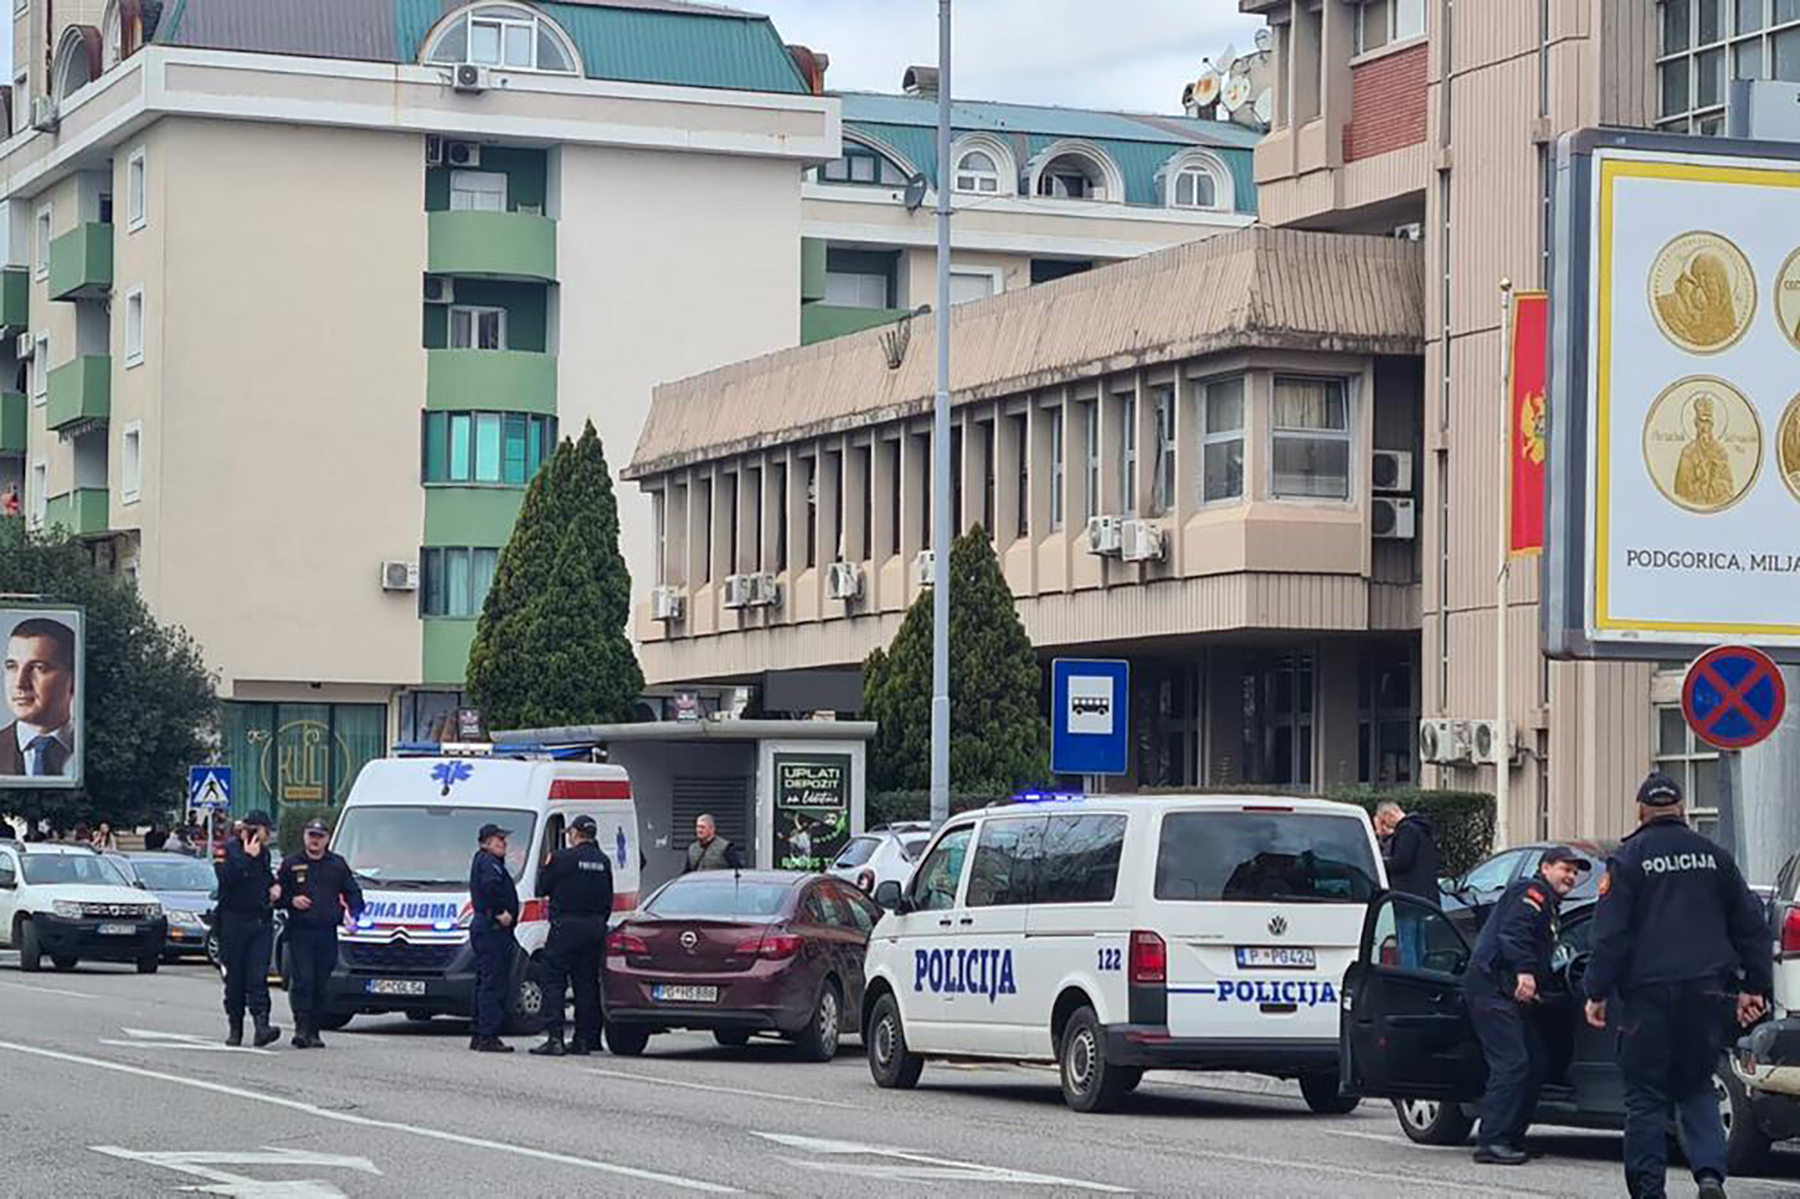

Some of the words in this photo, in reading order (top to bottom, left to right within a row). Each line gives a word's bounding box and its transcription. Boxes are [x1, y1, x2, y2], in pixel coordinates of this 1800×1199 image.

[1627, 549, 1745, 572] PODGORICA,
[784, 767, 840, 779] UPLATI
[784, 779, 838, 789] DEPOZIT
[1642, 853, 1717, 876] POLICIJA
[1098, 948, 1121, 970] 122
[914, 948, 1016, 1004] POLICIJA
[1217, 980, 1337, 1006] POLICIJA
